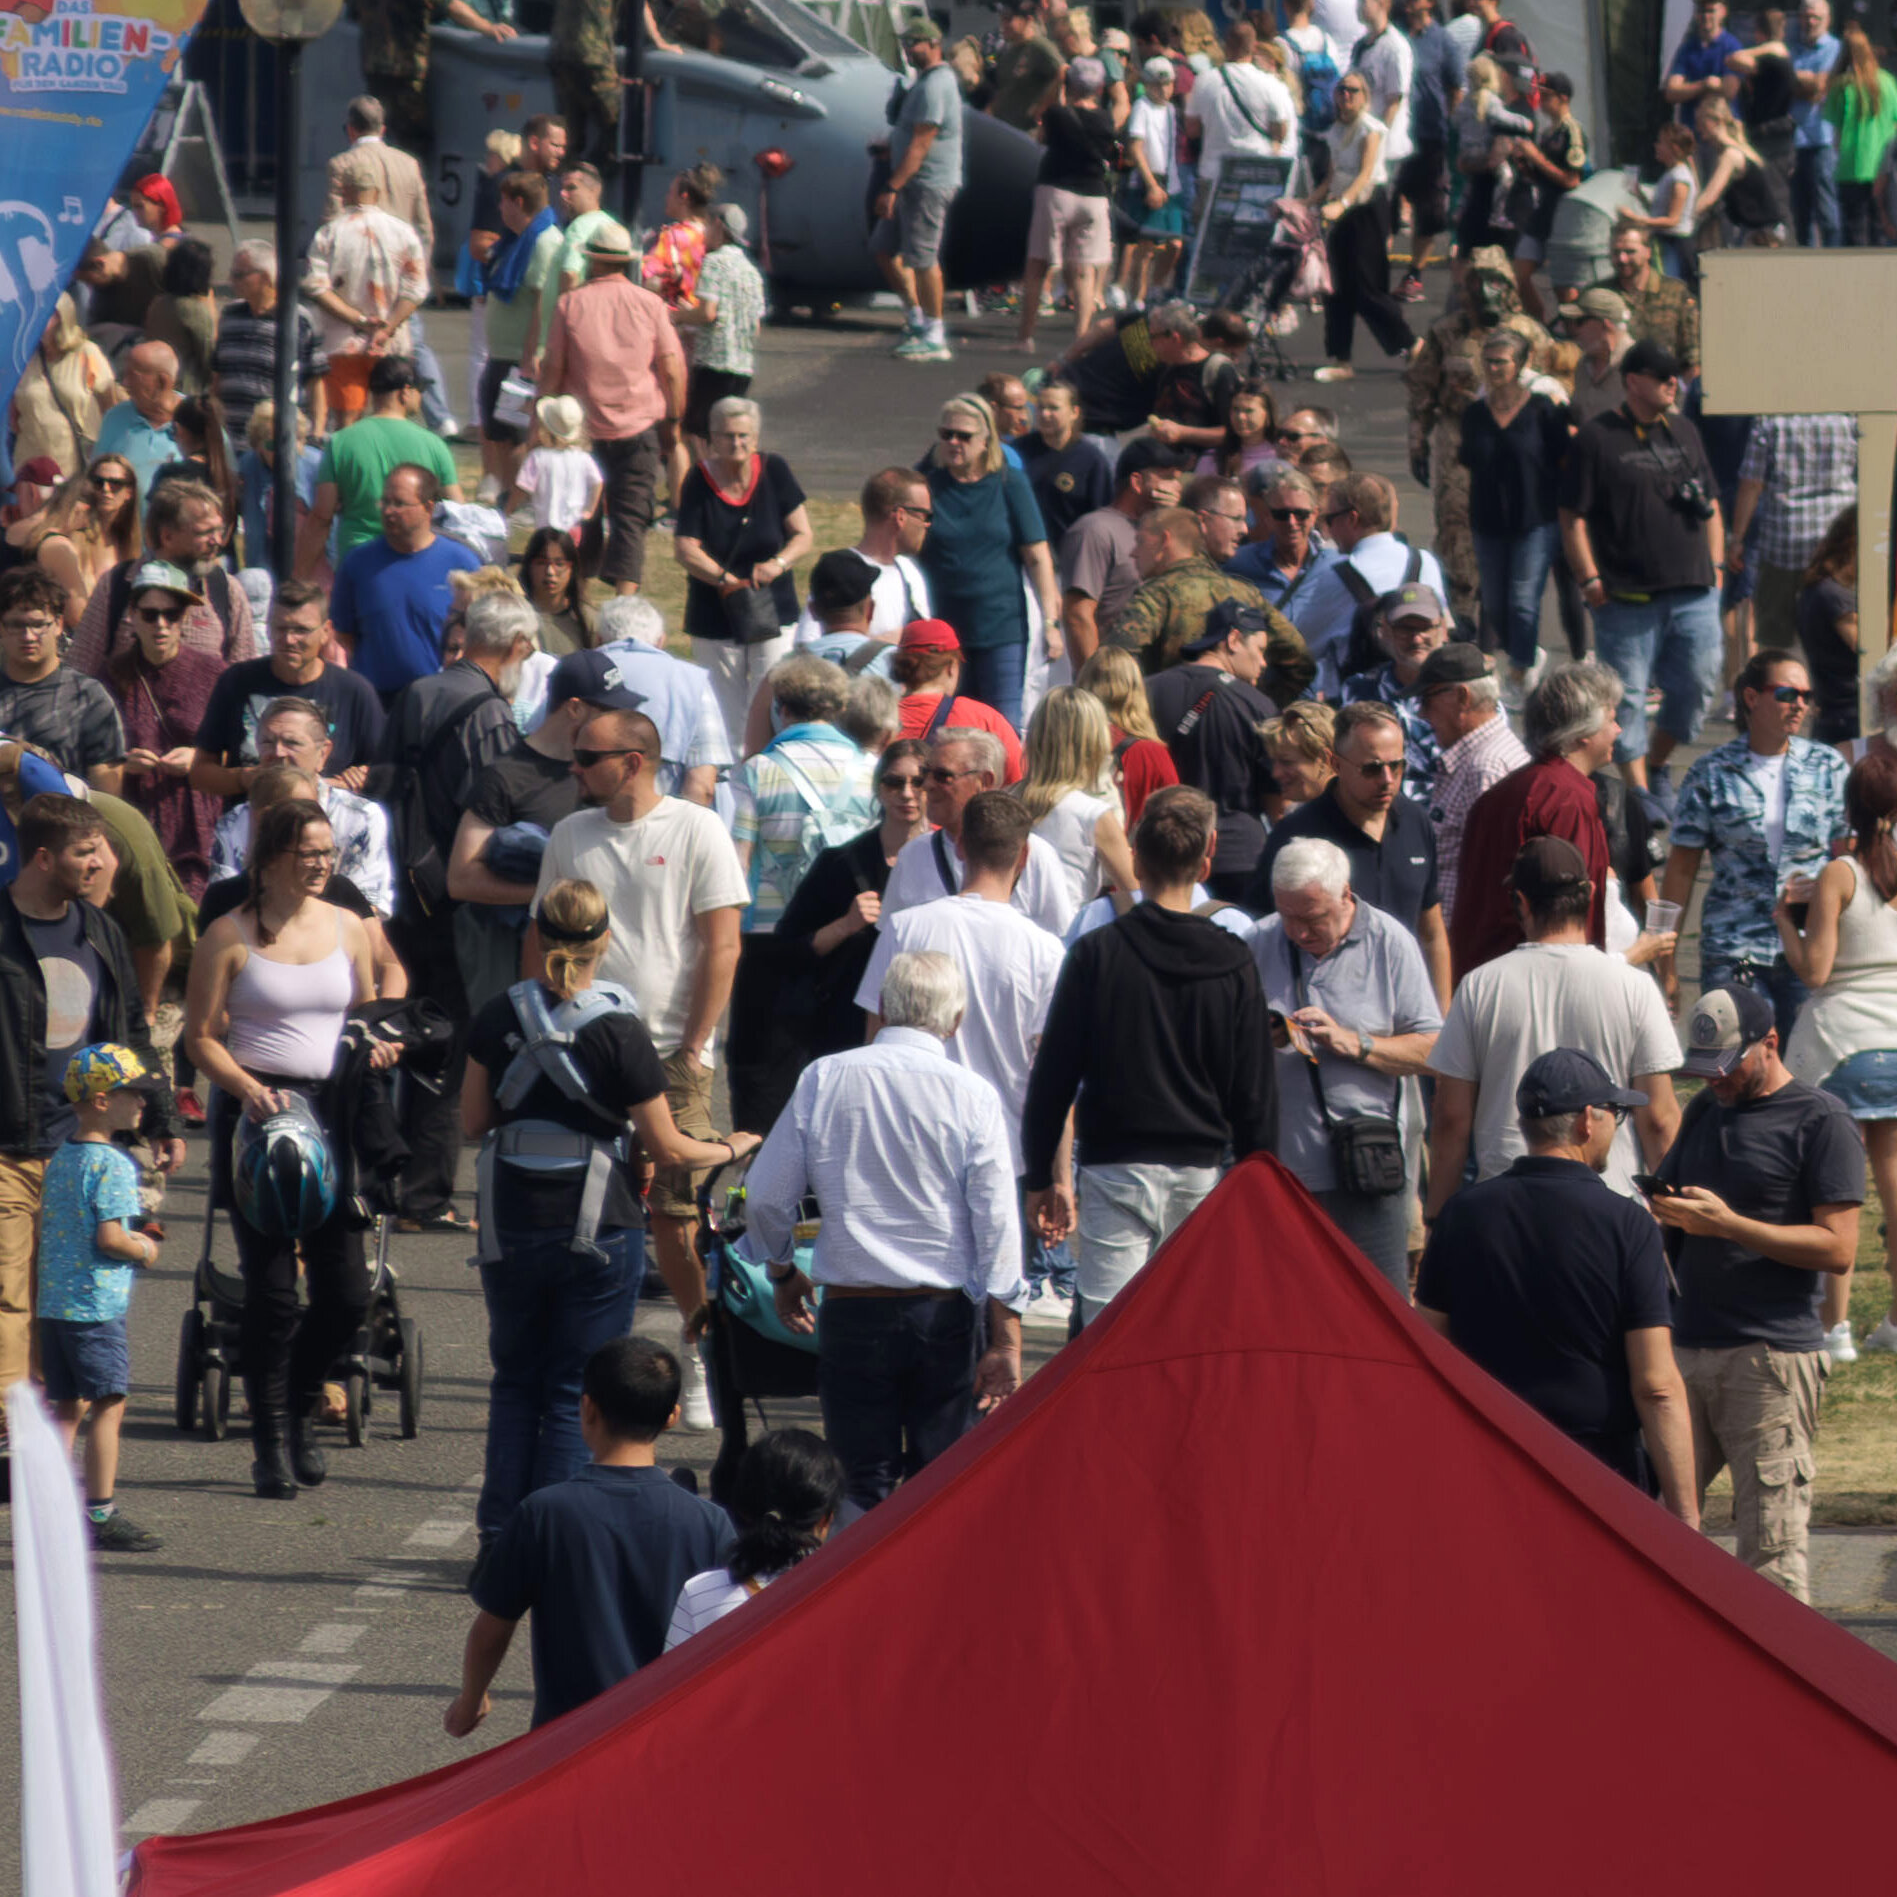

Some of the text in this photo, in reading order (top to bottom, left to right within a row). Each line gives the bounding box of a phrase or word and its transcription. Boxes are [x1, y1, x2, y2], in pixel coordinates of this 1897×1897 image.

[57, 0, 91, 14] DAS
[0, 18, 169, 52] FAMILIEN-
[22, 53, 122, 79] RADIO
